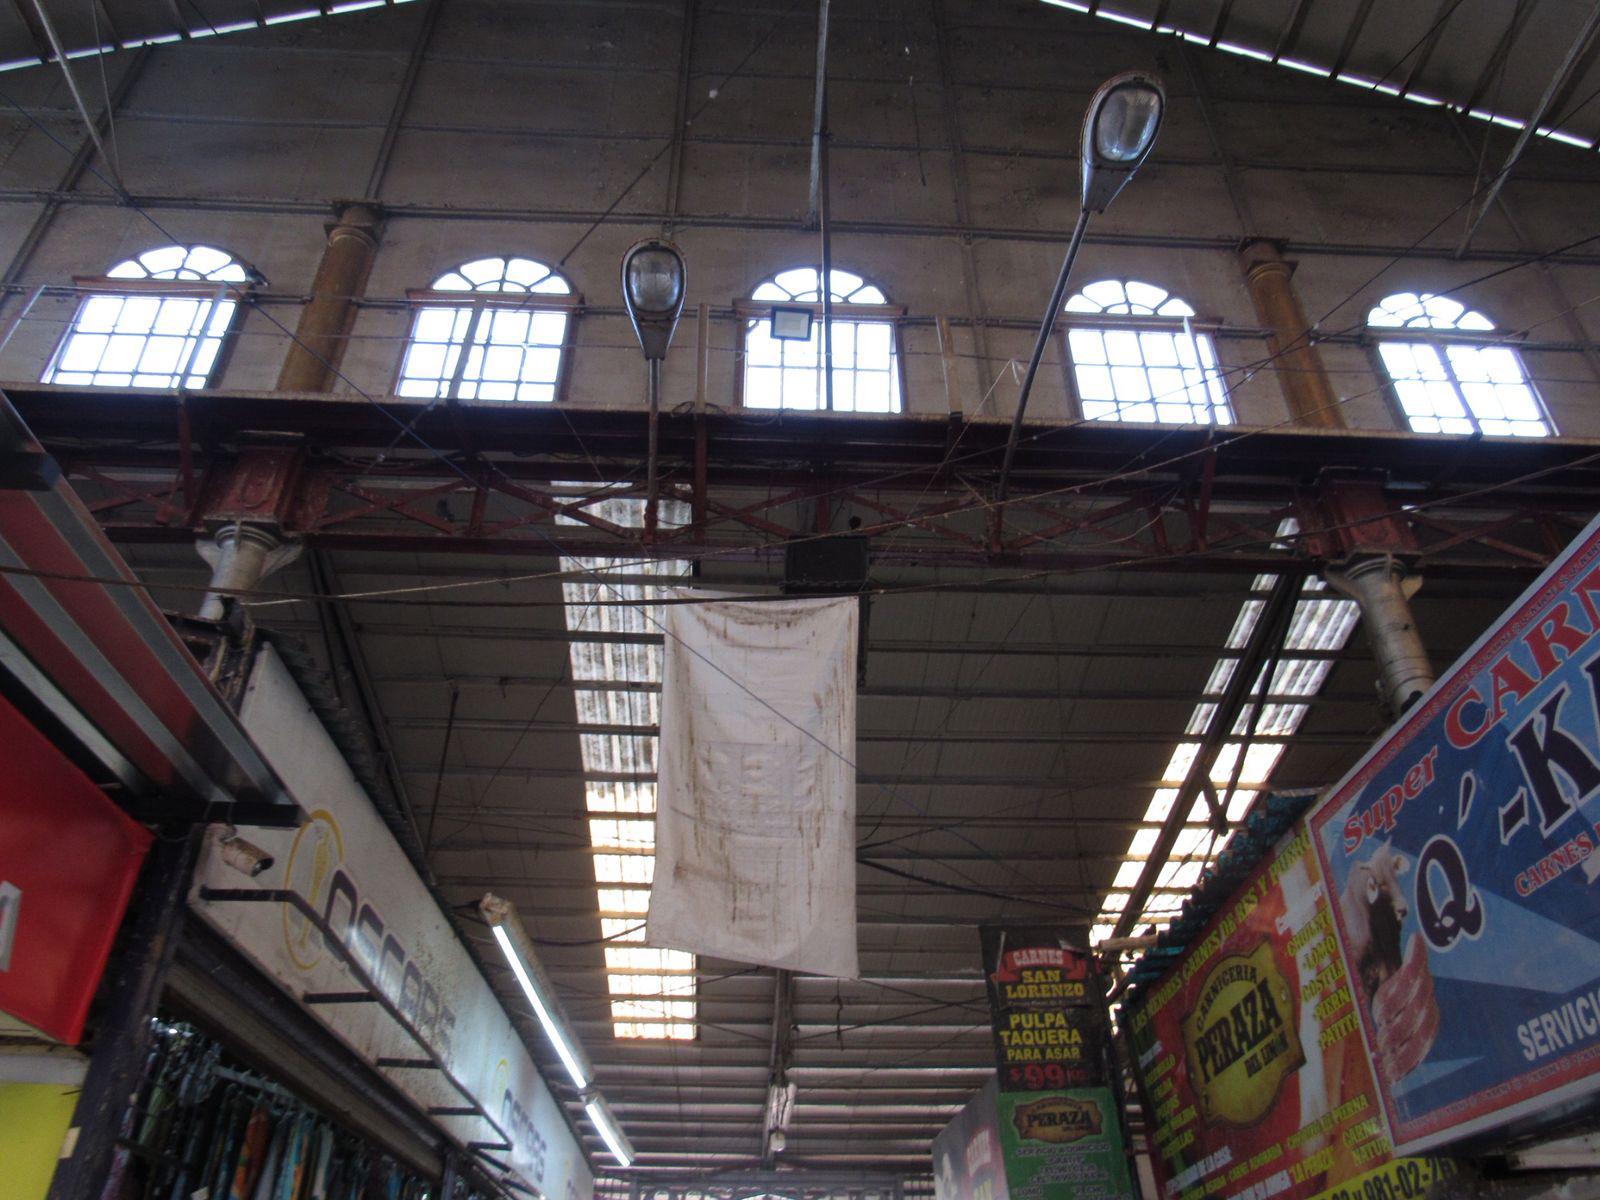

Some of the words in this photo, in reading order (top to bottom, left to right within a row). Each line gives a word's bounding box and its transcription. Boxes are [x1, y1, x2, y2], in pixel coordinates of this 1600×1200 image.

[1343, 745, 1438, 856] Super
[1515, 831, 1594, 898] CARNES
[1013, 949, 1064, 966] CARNES
[1021, 969, 1061, 983] SAN
[1005, 982, 1085, 999] LORENZO
[1197, 964, 1257, 1033] CARNICERIA
[1009, 1012, 1068, 1029] PULPA
[1516, 987, 1600, 1061] SERVICI
[1000, 1028, 1083, 1046] TAQUERA
[1195, 977, 1284, 1084] PERAZA
[1006, 1047, 1042, 1061] PARA
[1045, 1046, 1082, 1060] ASAR
[1026, 1109, 1093, 1130] PERAZA
